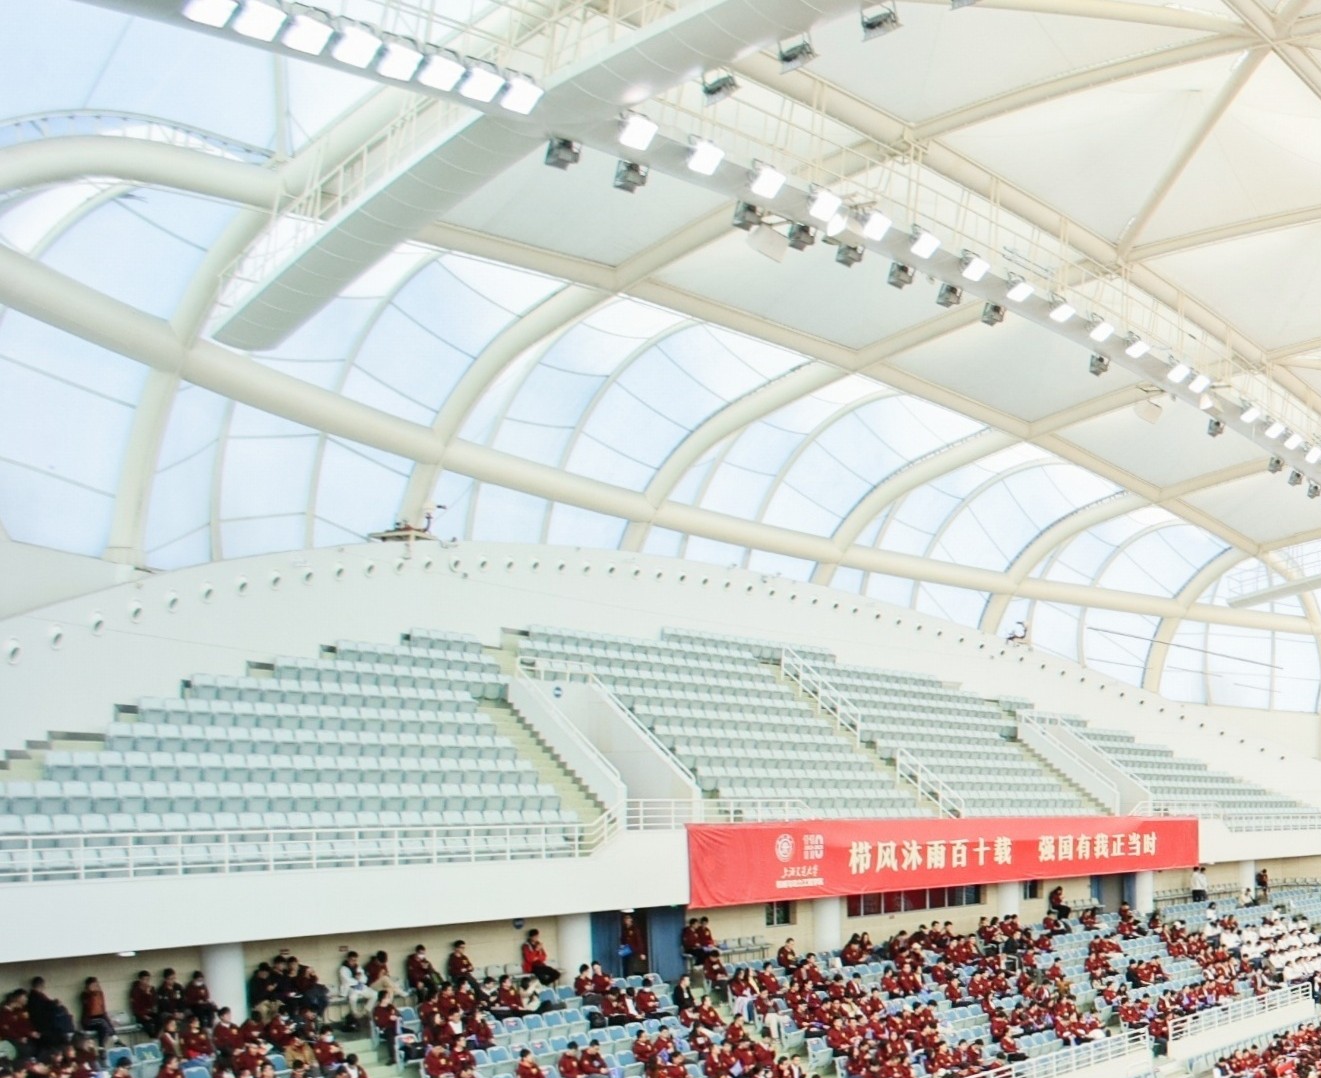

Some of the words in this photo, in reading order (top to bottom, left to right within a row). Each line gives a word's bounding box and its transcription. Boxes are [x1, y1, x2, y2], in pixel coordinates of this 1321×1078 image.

[848, 836, 1013, 875] 栉风沐雨百十载
[1038, 831, 1158, 862] 强国有我正当时
